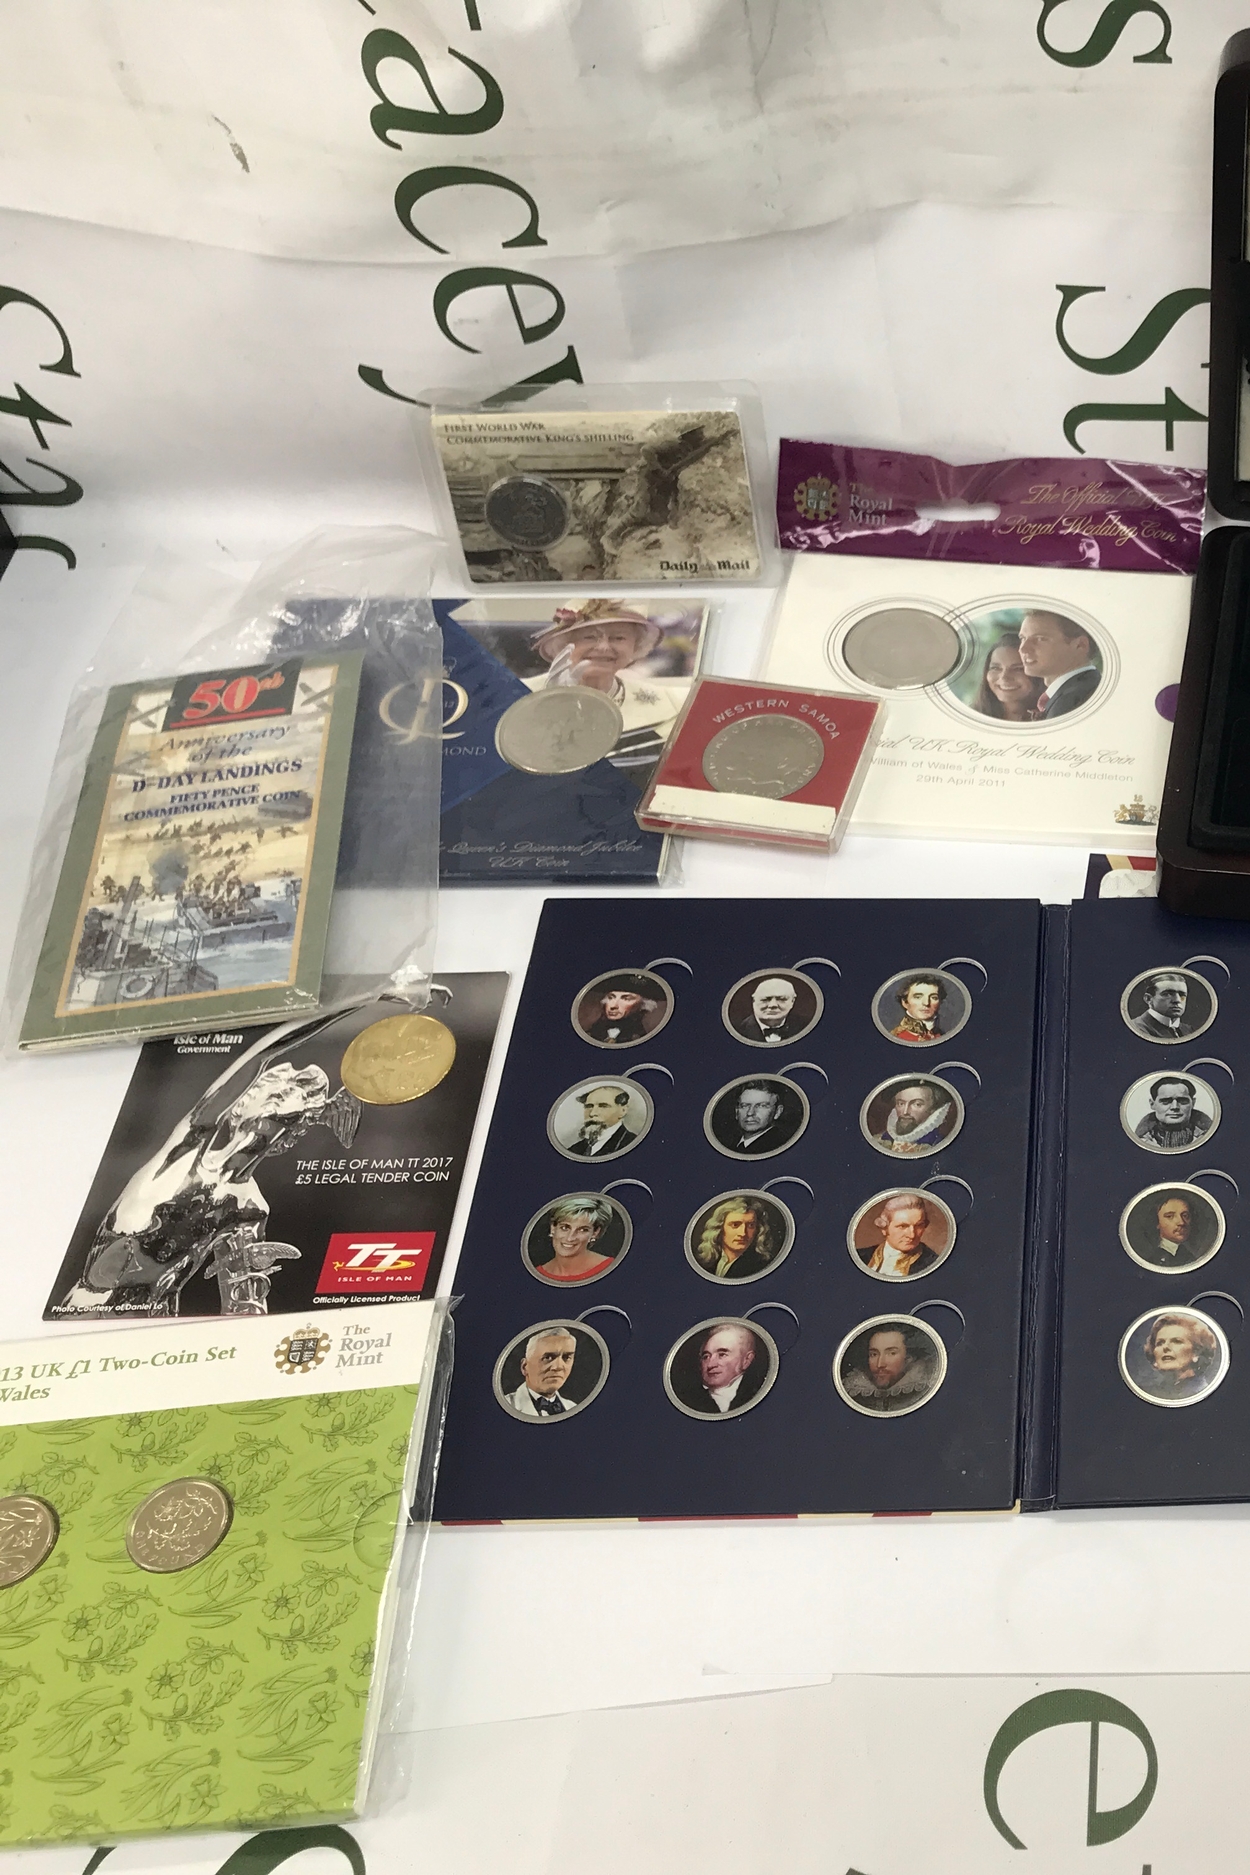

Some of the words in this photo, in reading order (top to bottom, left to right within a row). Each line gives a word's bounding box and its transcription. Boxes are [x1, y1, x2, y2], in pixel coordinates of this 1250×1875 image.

[444, 424, 472, 433] FIRST
[475, 422, 518, 432] WORLD
[519, 421, 546, 431] WAR
[446, 434, 541, 445] COMMEMORATIVE
[850, 493, 893, 513] Royal
[1020, 483, 1060, 504] The
[1062, 482, 1125, 512] Official
[848, 508, 888, 526] Mint
[998, 514, 1065, 545] Royal
[1059, 515, 1138, 546] Wedding
[1141, 520, 1177, 543] Coin
[659, 559, 698, 573] Daily
[717, 559, 750, 571] Mail
[712, 698, 790, 724] WESTERN
[798, 703, 841, 741] SAMOA
[160, 725, 291, 752] Anniversary
[188, 748, 214, 763] of
[217, 744, 254, 760] the
[908, 736, 955, 753] UK
[948, 740, 1018, 762] Royal
[1016, 744, 1093, 768] Wedding
[1097, 749, 1136, 765] Coin
[131, 771, 201, 793] D-DAY
[200, 758, 303, 784] LANDINGS
[911, 760, 924, 768] of
[927, 761, 963, 771] Wales
[983, 765, 1010, 774] Miss
[1014, 767, 1071, 778] Catherine
[1075, 771, 1134, 782] Middleton
[916, 774, 943, 784] 29th
[946, 776, 974, 786] April
[978, 778, 1006, 788] 2011
[169, 789, 211, 804] FIFTY
[212, 783, 261, 798] PENCE
[123, 796, 260, 822] COMMEMORATIVE
[262, 789, 301, 803] COIN
[509, 839, 590, 854] Diamond
[173, 1033, 197, 1045] Isle
[198, 1033, 212, 1045] of
[212, 1033, 244, 1044] Man
[177, 1045, 231, 1054] Government
[296, 1159, 320, 1171] THE
[321, 1159, 347, 1170] ISLE
[349, 1158, 369, 1170] OF
[370, 1158, 405, 1169] MAN
[407, 1157, 421, 1169] TT
[422, 1156, 454, 1168] 2017
[295, 1173, 312, 1185] £5
[314, 1172, 357, 1185] LEGAL
[361, 1171, 411, 1183] TENDER
[412, 1170, 450, 1182] COIN
[51, 1305, 75, 1313] Photo
[76, 1304, 114, 1313] Courtesy
[125, 1302, 152, 1311] Daniel
[312, 1295, 349, 1305] Officially
[350, 1295, 387, 1304] Licensed
[388, 1294, 421, 1302] Product
[342, 1323, 371, 1336] The
[338, 1332, 393, 1355] Royal
[0, 1366, 24, 1382] 13
[30, 1362, 65, 1379] UK
[65, 1359, 92, 1379] £1
[99, 1349, 199, 1373] Two-Coin
[205, 1345, 238, 1362] Set
[335, 1350, 384, 1369] Mint
